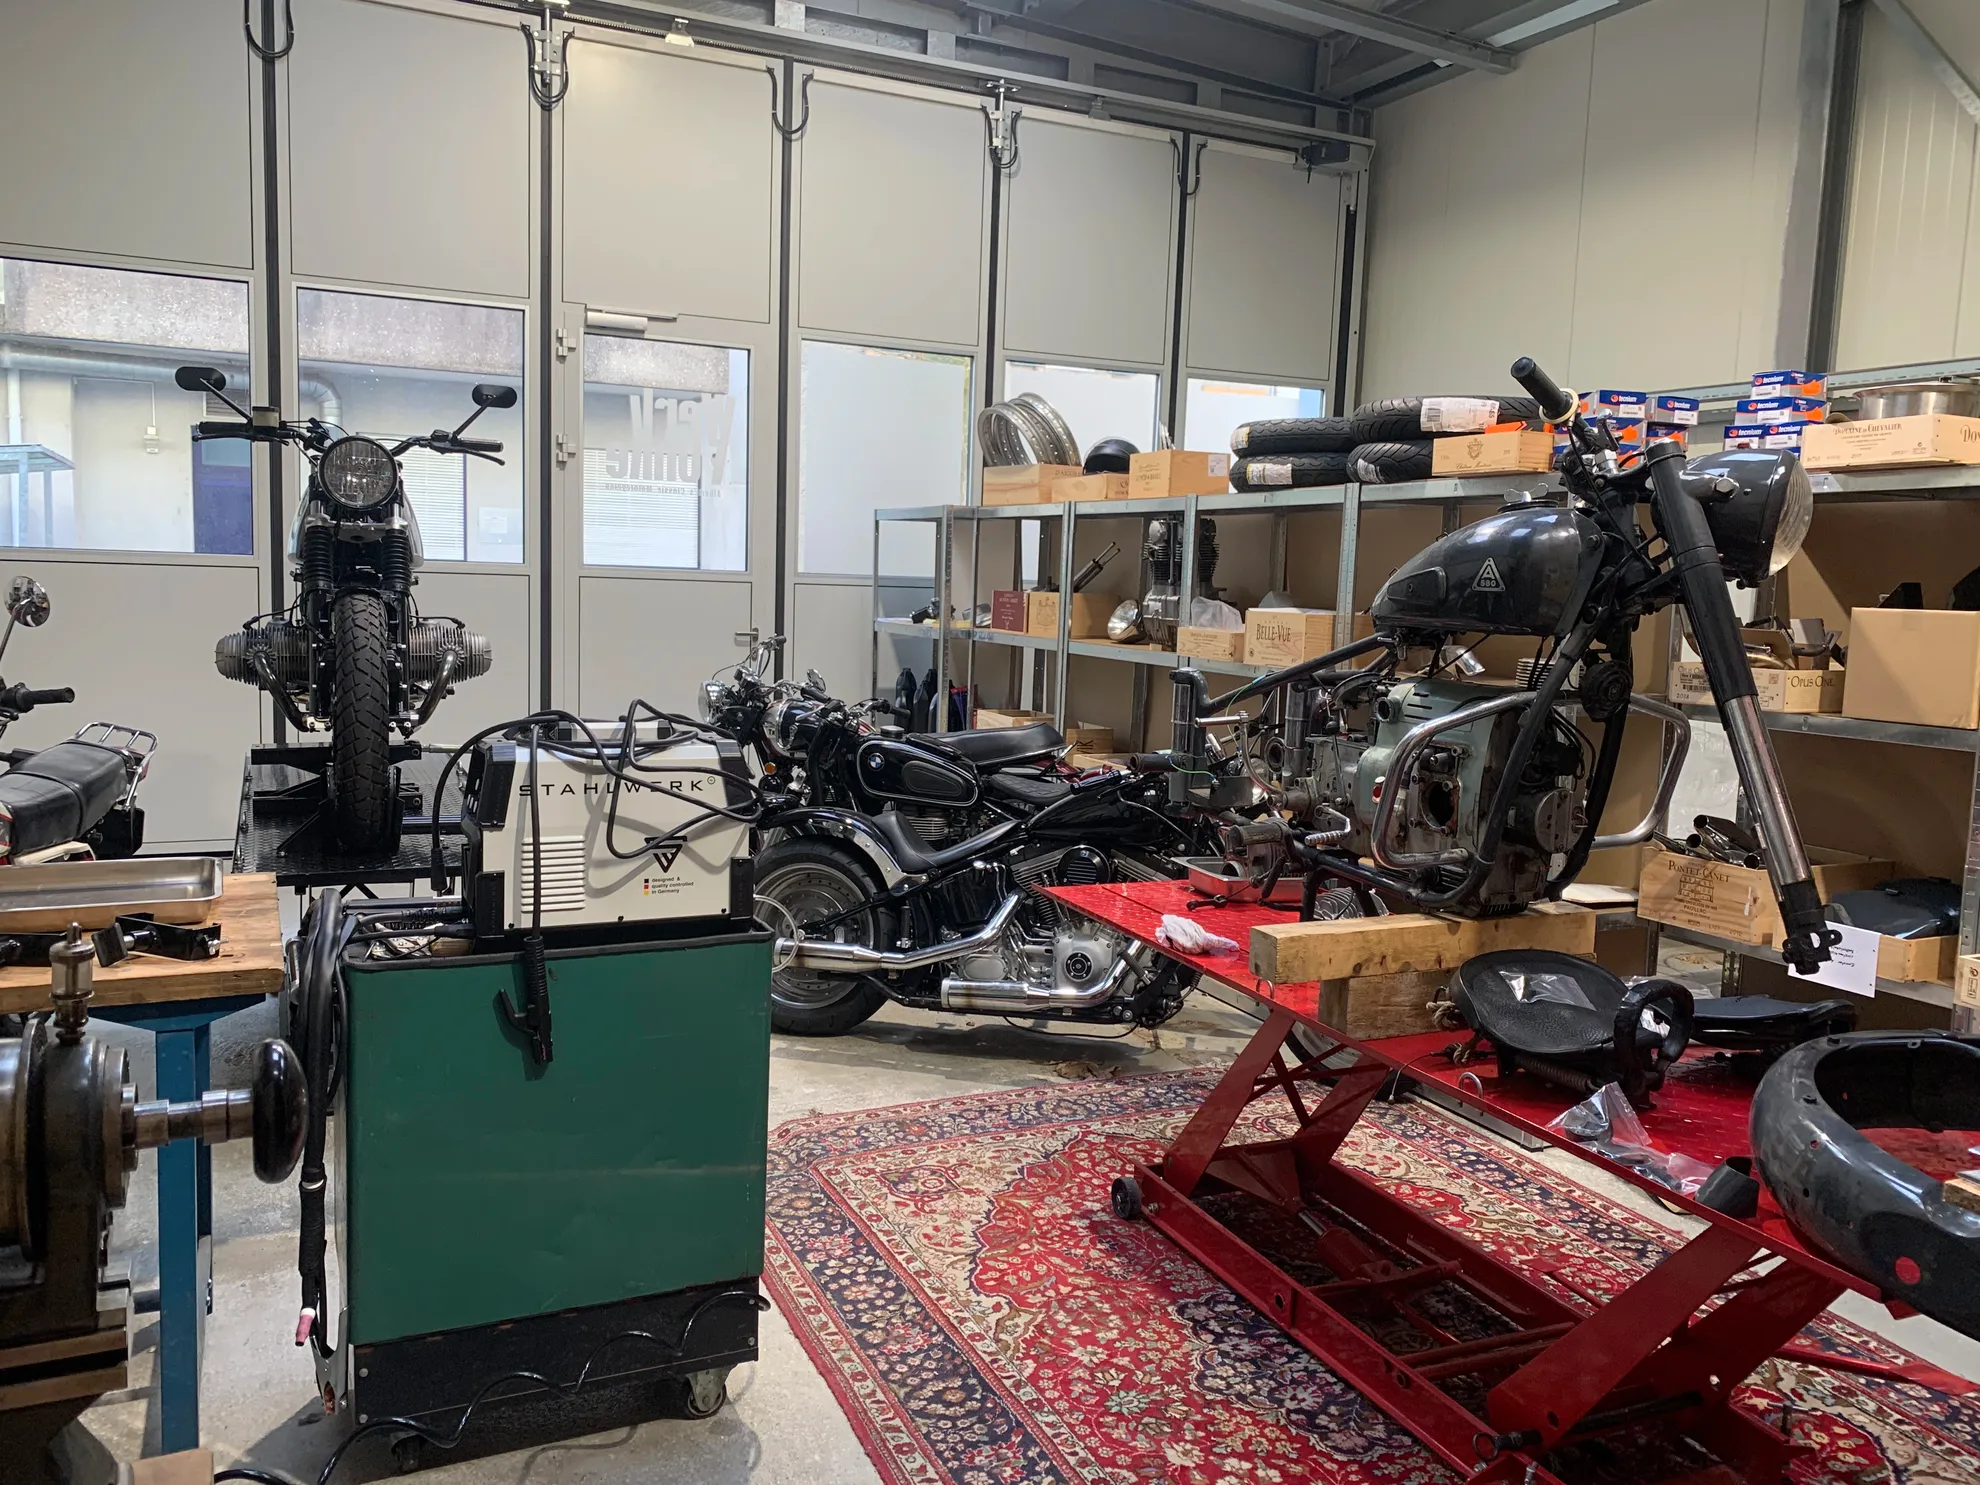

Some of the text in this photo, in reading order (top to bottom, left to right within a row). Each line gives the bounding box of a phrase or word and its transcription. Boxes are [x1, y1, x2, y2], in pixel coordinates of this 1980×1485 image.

[1481, 565, 1495, 580] A
[1256, 623, 1291, 642] BELLE-VUE
[1790, 675, 1835, 688] OPUS ONE
[1668, 859, 1731, 883] PONTET-CANET
